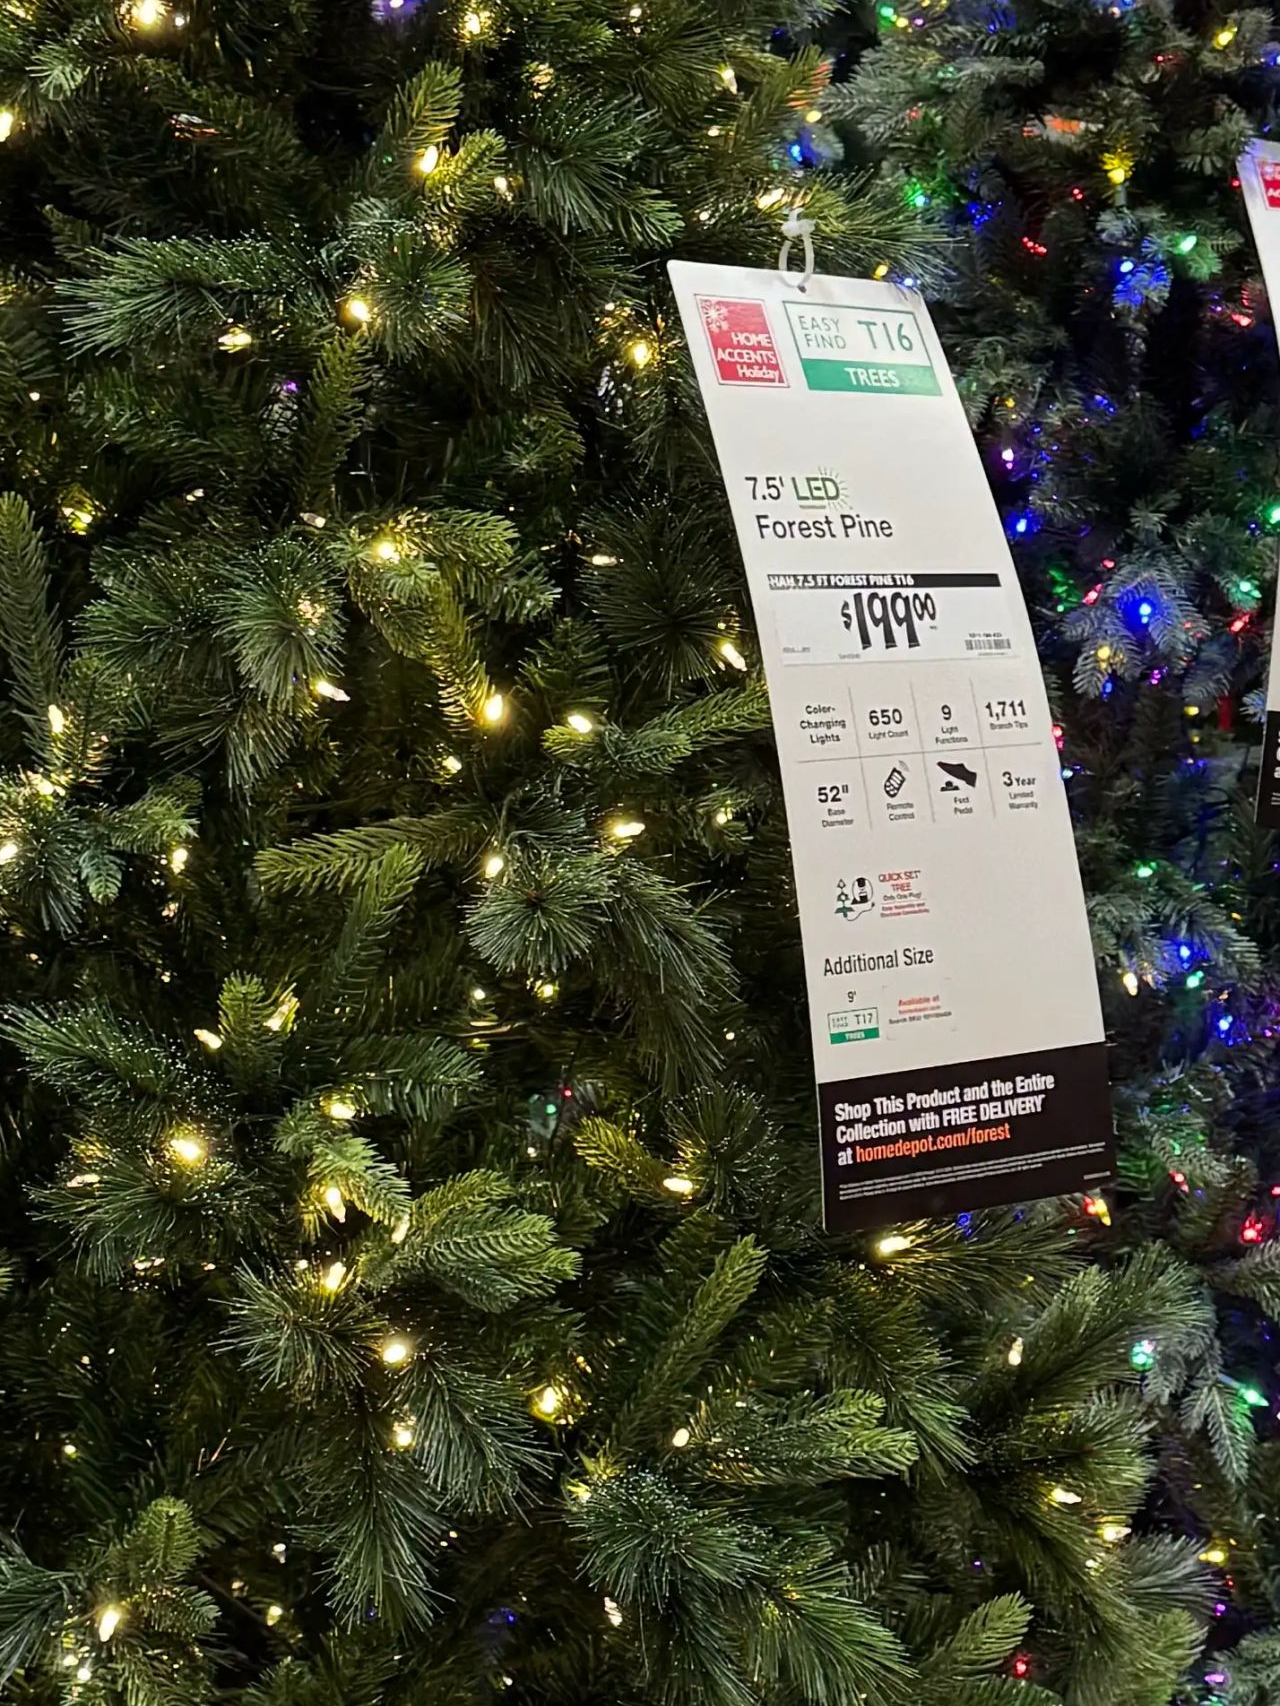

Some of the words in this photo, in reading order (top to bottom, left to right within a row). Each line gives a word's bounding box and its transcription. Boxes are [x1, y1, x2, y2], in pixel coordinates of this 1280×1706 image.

[731, 332, 772, 348] HOME
[798, 315, 841, 332] EASY
[856, 319, 914, 353] T16
[806, 334, 848, 351] FIND
[717, 348, 778, 366] ACCENTS
[737, 364, 780, 384] Holiday
[844, 366, 901, 389] TREES
[744, 475, 785, 501] 7.5'
[791, 476, 841, 502] LED
[755, 514, 837, 540] Forest
[840, 513, 894, 539] Pine
[796, 574, 816, 588] 7.5
[829, 574, 868, 587] FOREST
[869, 574, 894, 586] PINE
[893, 574, 916, 586] T16
[805, 704, 837, 716] Color-
[868, 708, 904, 727] 650
[940, 704, 953, 721] 9
[985, 699, 1027, 720] 1,711
[799, 718, 847, 731] Changing
[809, 732, 842, 746] Lights
[868, 730, 888, 741] Light
[887, 729, 909, 739] Count
[935, 735, 969, 745] Functions
[1001, 770, 1014, 788] 3
[1014, 776, 1038, 788] Year
[817, 783, 850, 805] 52"
[878, 871, 903, 884] QUICK
[891, 881, 913, 893] TREE
[822, 948, 900, 978] Additional
[902, 946, 935, 968] Size
[847, 990, 858, 1004] 9'
[834, 1100, 872, 1122] Shop
[874, 1096, 905, 1118] This
[906, 1088, 962, 1113] Product
[963, 1082, 990, 1102] and
[990, 1078, 1014, 1098] the
[1015, 1072, 1056, 1095] Entire
[835, 1118, 907, 1145] Collection
[908, 1111, 941, 1134] with
[942, 1105, 979, 1128] FREE
[837, 1148, 855, 1167] at
[854, 1122, 1012, 1164] homedepot.com/forest
